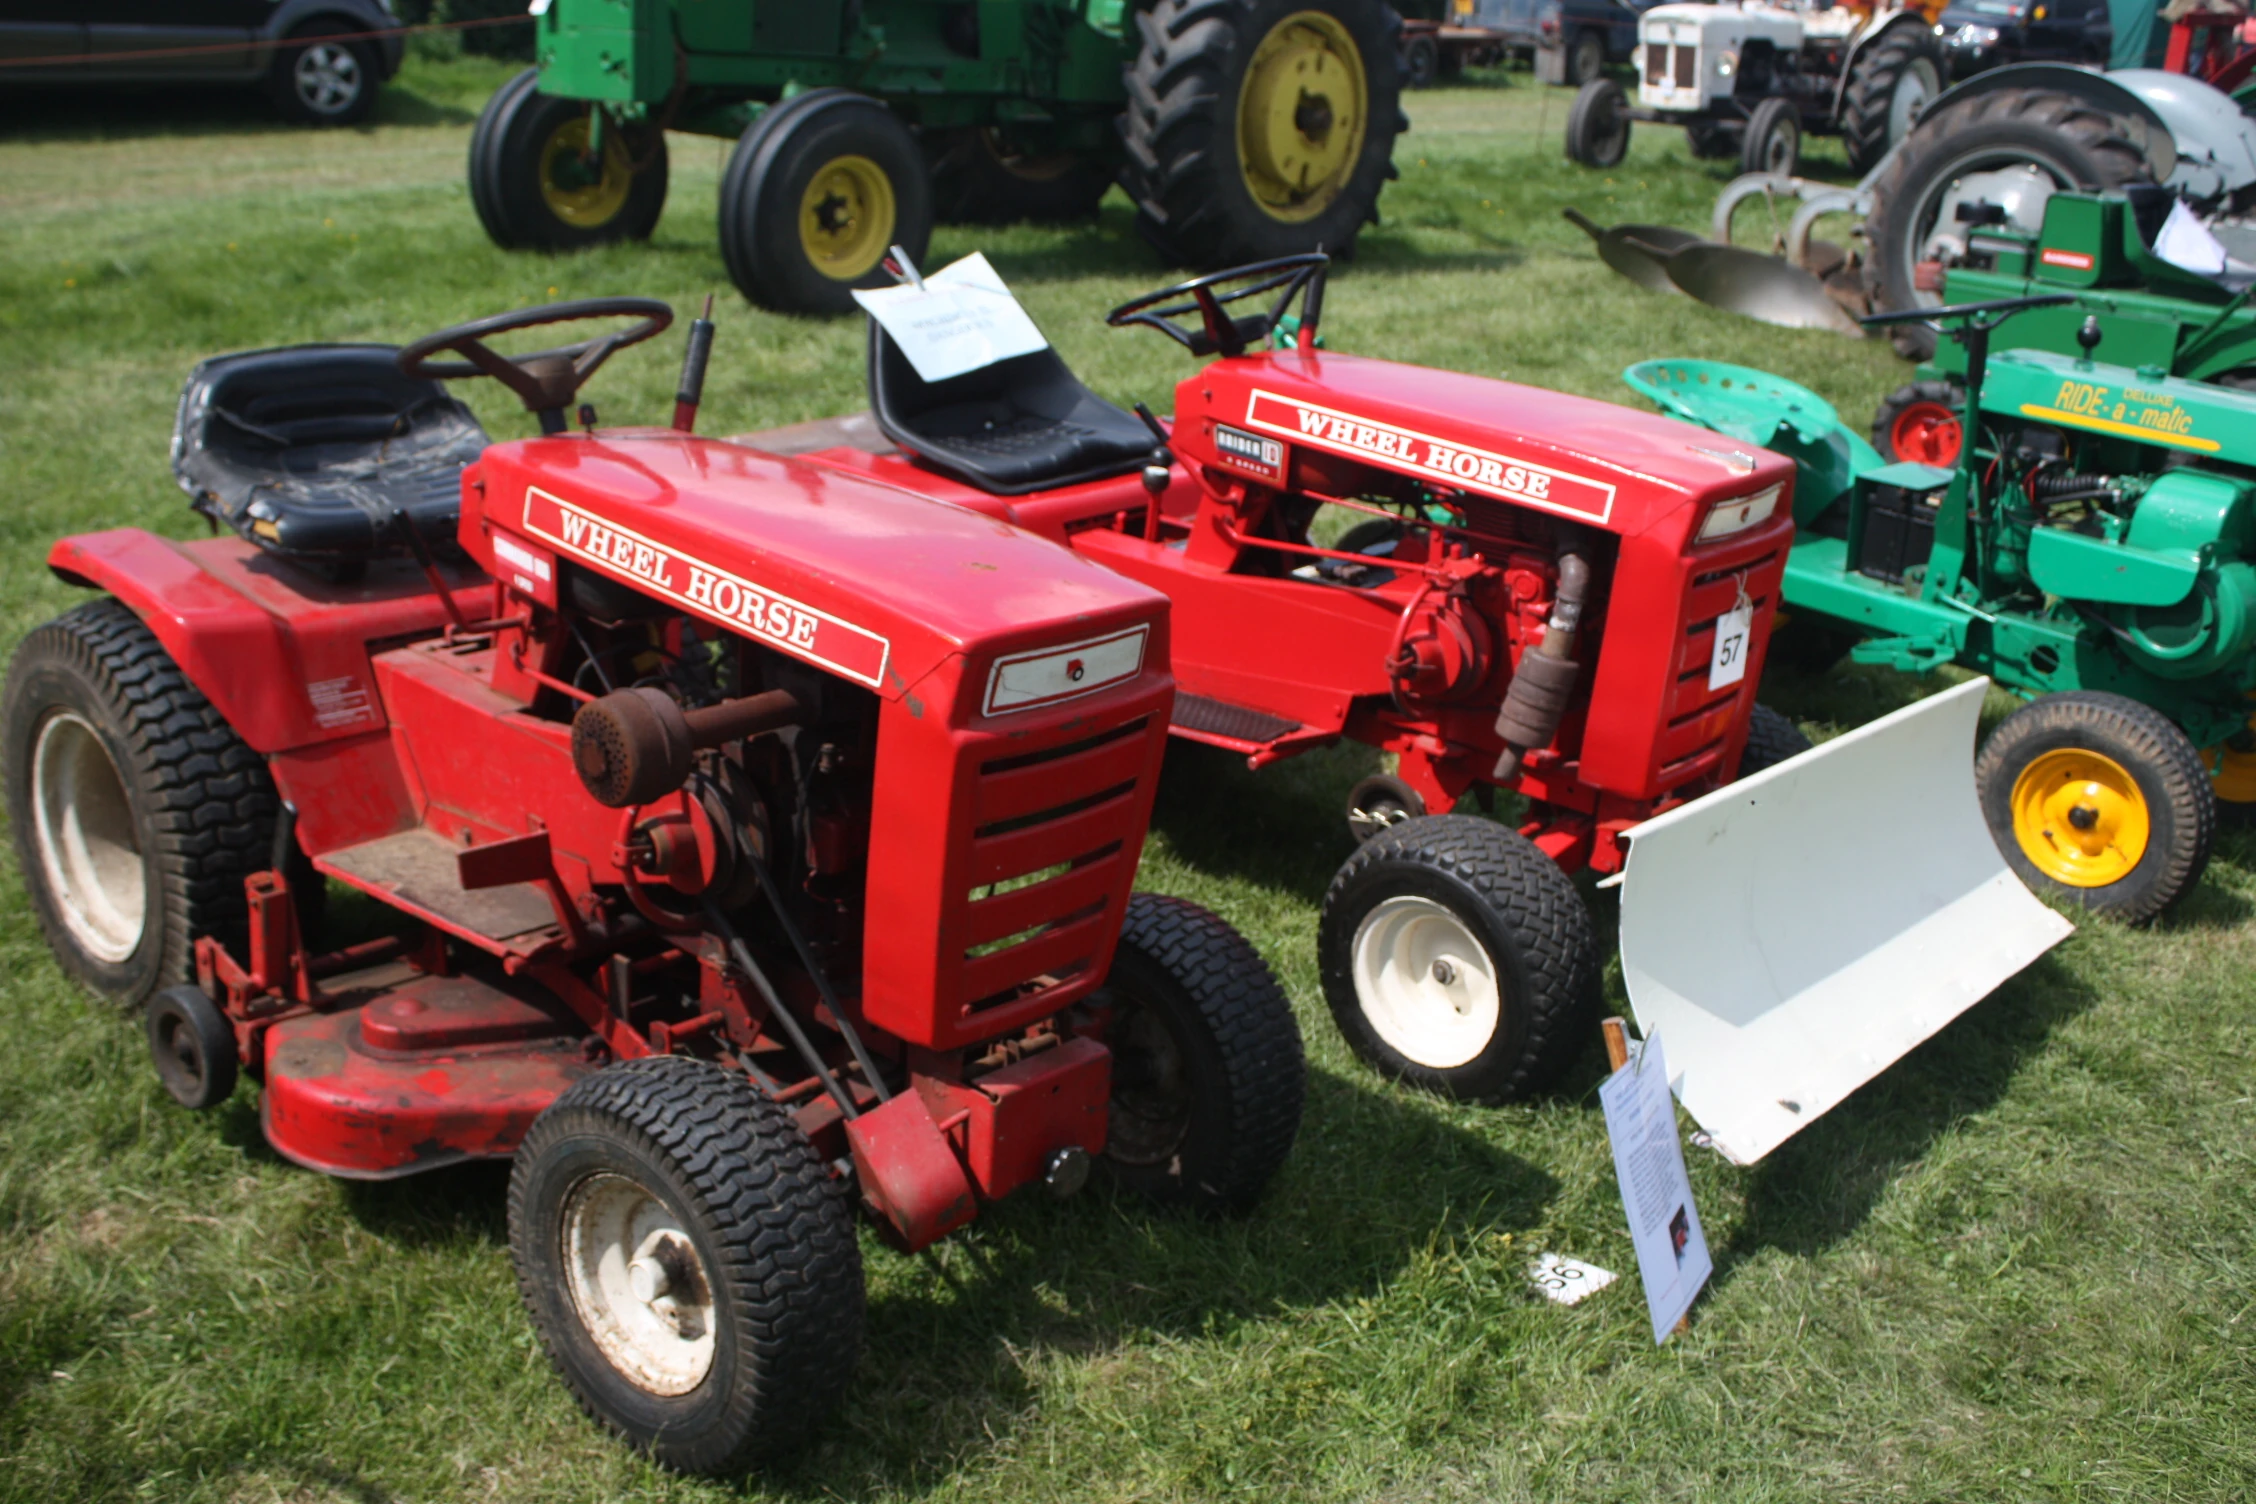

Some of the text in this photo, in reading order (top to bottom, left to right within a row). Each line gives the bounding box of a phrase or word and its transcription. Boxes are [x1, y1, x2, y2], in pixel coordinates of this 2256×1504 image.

[1297, 408, 1551, 500] WHEEL HORSE
[560, 508, 672, 588] WHEEL
[684, 566, 819, 650] HORSE
[1720, 632, 1744, 667] 57
